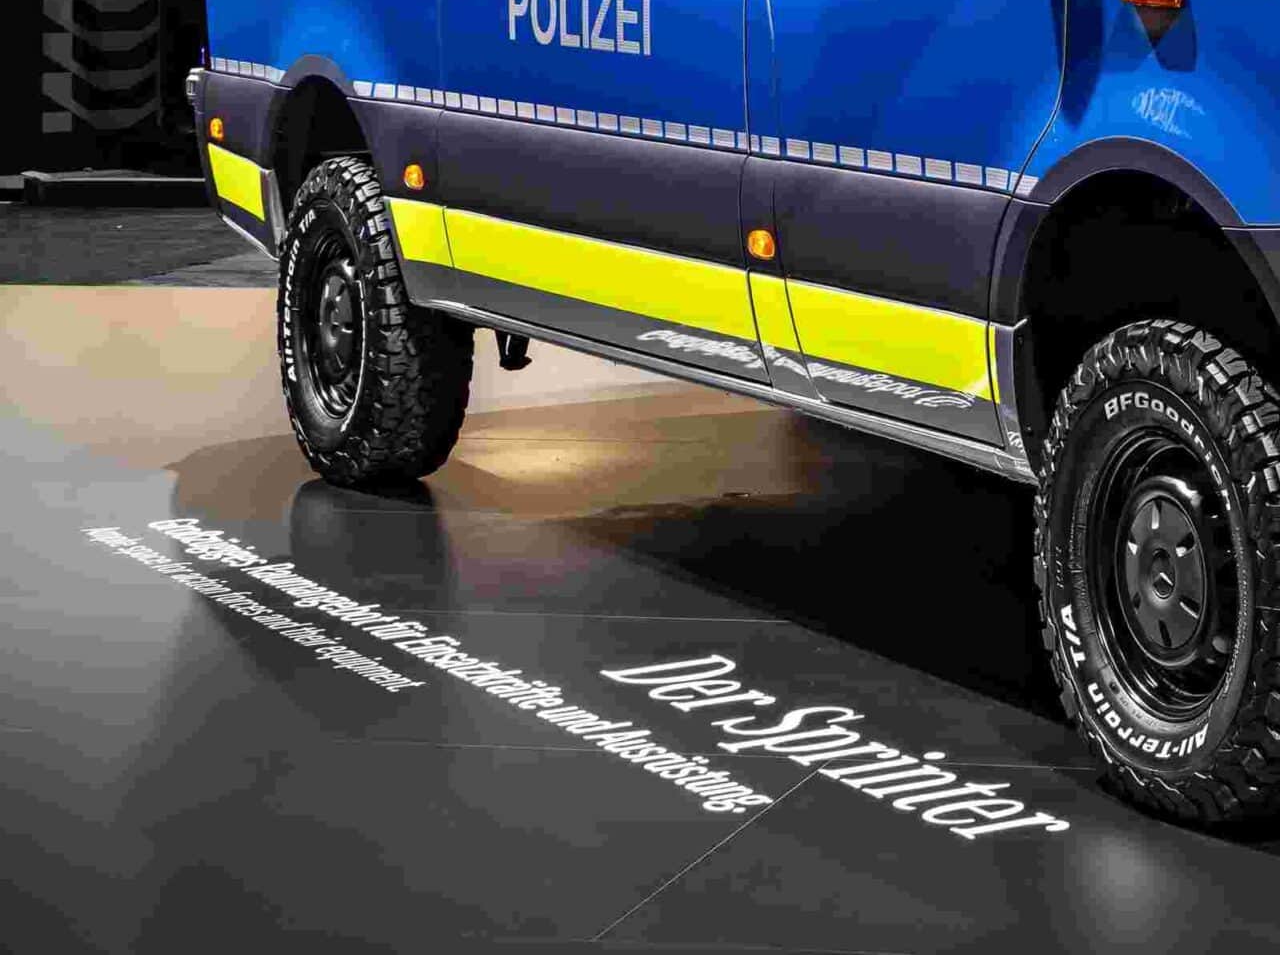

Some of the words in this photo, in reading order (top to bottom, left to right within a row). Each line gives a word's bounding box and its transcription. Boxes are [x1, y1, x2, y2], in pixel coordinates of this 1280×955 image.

[240, 562, 401, 626] Raumangebot
[362, 621, 429, 640] für
[1060, 603, 1087, 668] T/A
[315, 645, 427, 693] equipment
[393, 635, 565, 710] Einsatzkräfte
[536, 706, 633, 734] und
[600, 653, 777, 713] Der
[711, 706, 1071, 840] Sprinter
[1087, 682, 1209, 759] All-Terrain
[583, 730, 774, 813] Ausrüstung.
